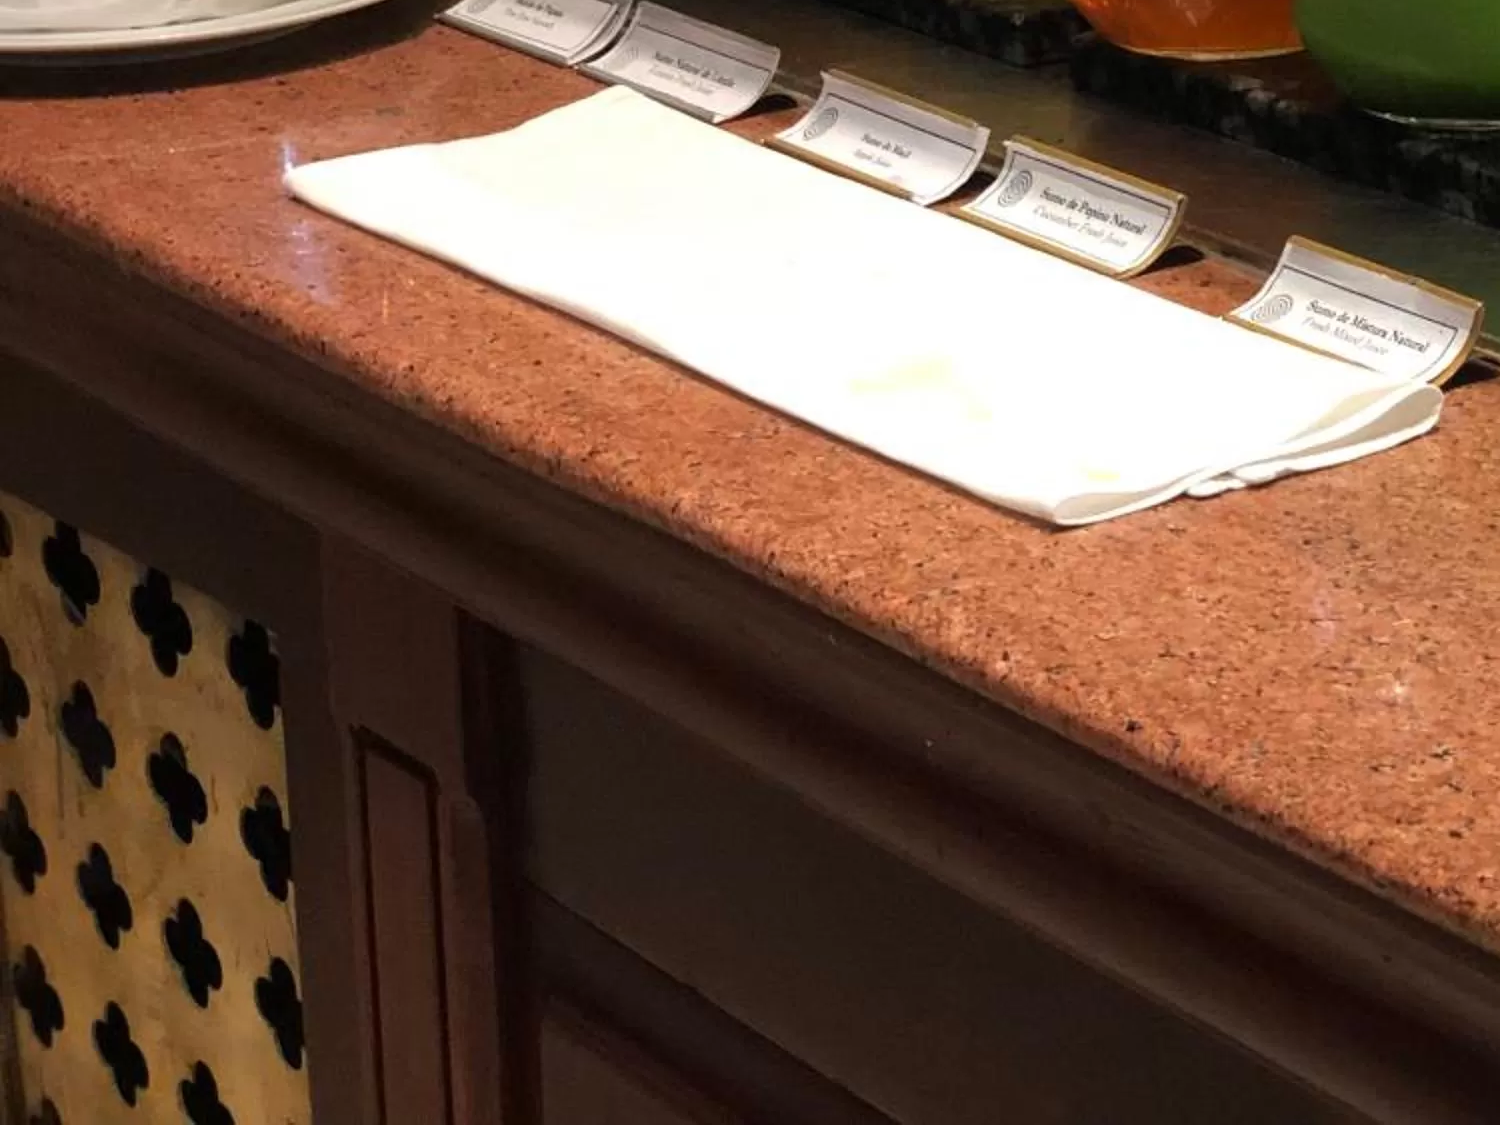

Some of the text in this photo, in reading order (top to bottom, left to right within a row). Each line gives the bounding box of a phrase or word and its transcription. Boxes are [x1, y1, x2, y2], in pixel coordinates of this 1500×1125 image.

[1306, 299, 1337, 319] Sumo
[1336, 311, 1350, 324] de
[1387, 330, 1431, 354] Natural
